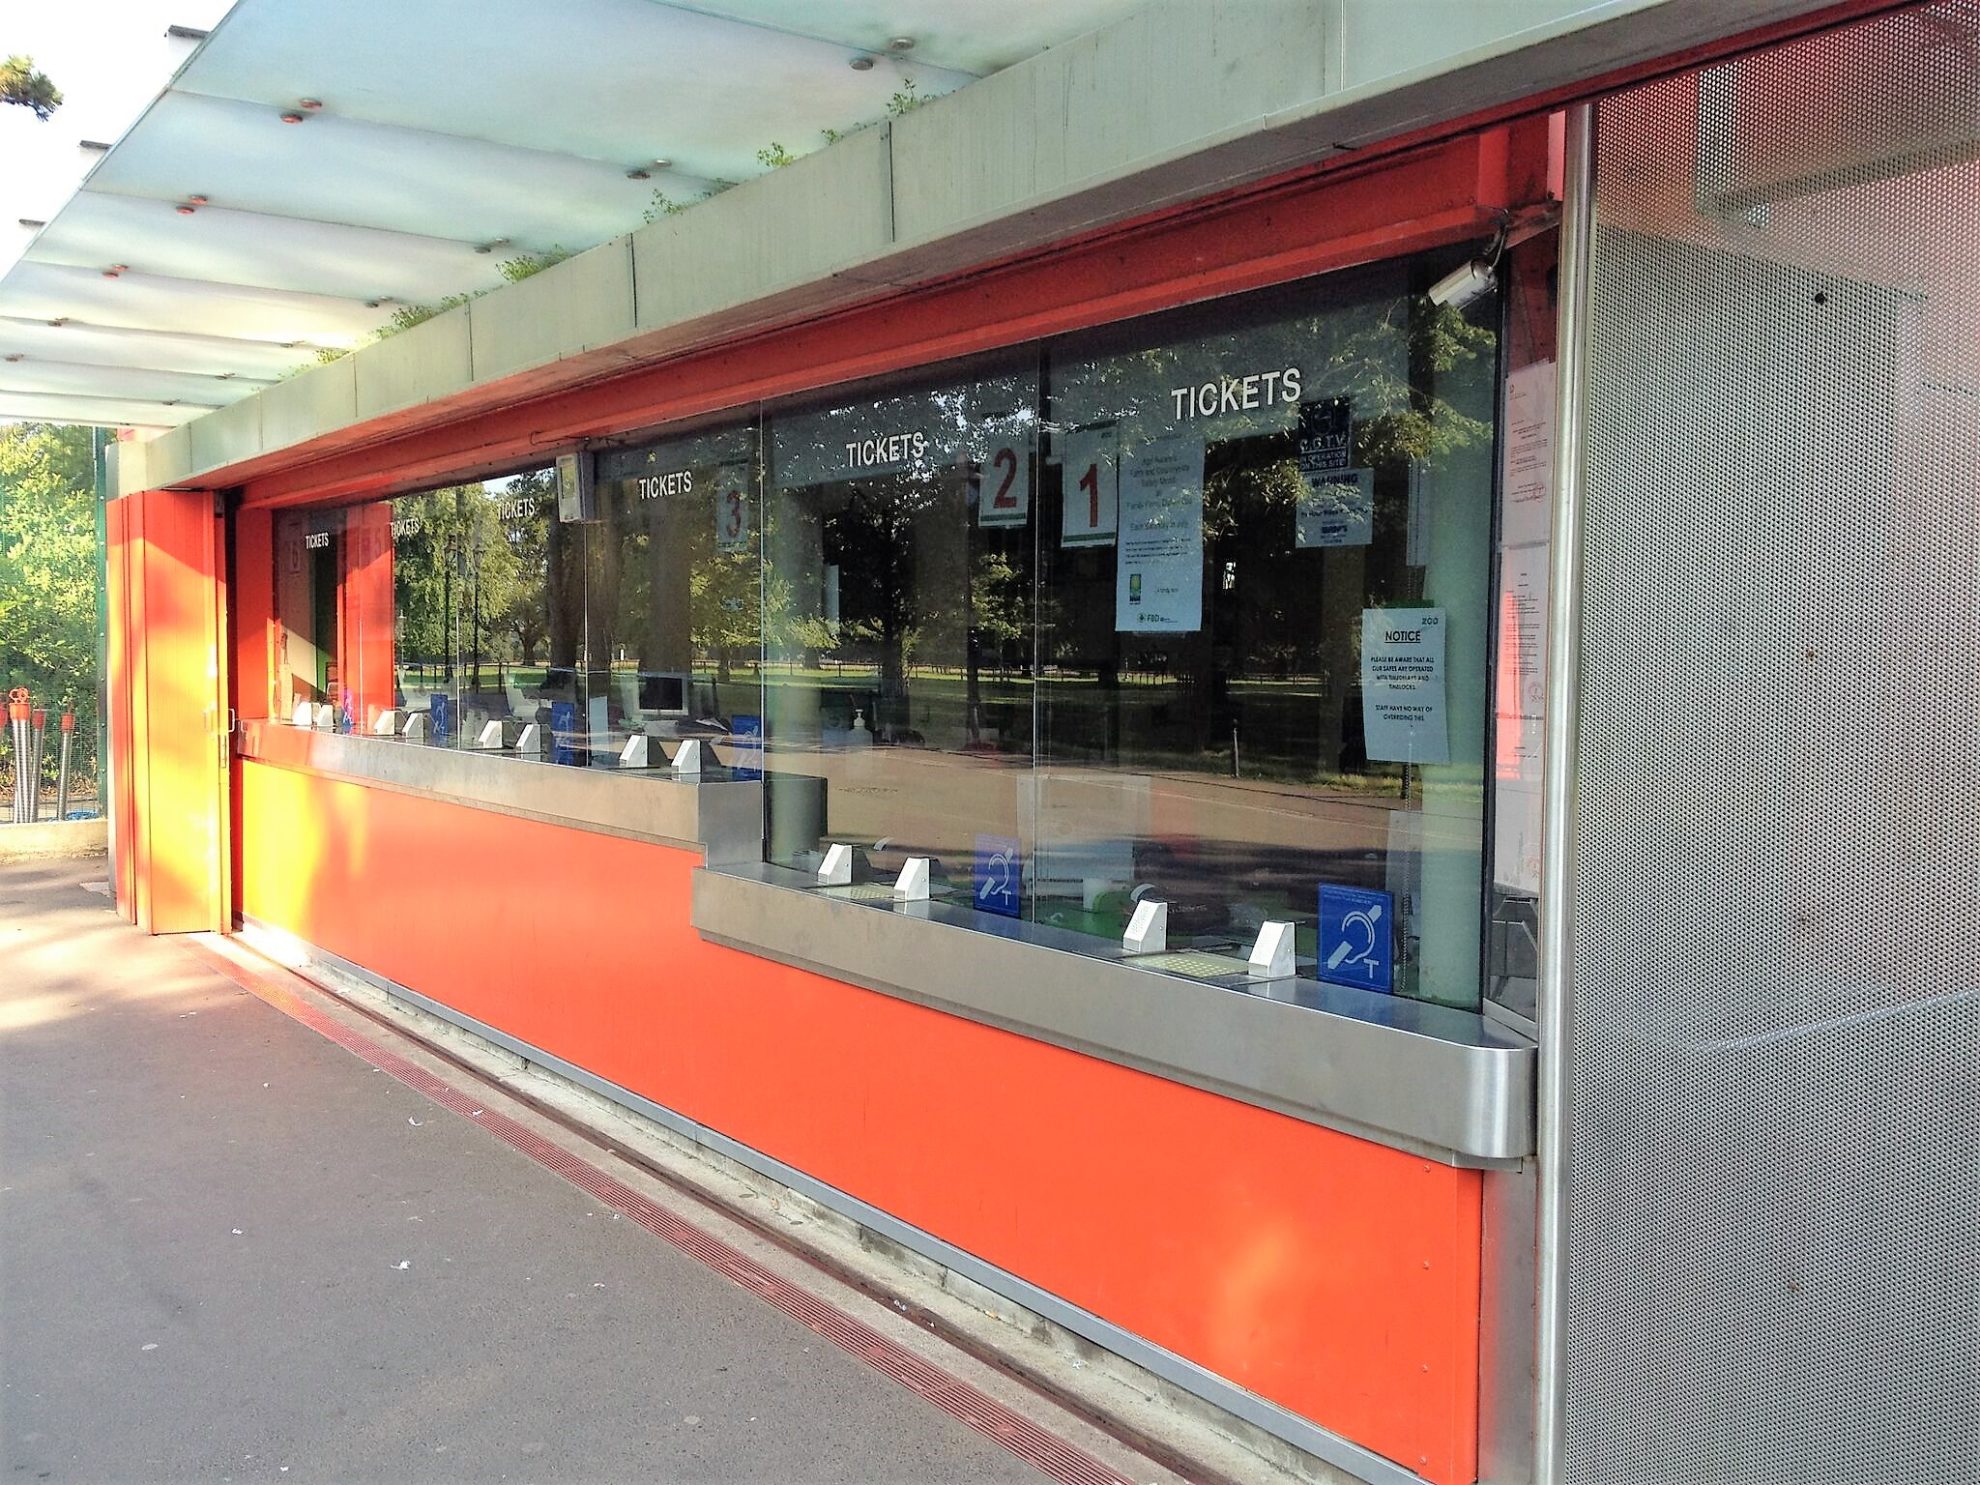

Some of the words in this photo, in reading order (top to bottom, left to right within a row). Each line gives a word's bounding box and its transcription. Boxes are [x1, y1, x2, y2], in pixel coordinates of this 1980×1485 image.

[1171, 368, 1301, 420] TICKETS
[845, 431, 926, 468] TICKETS
[639, 471, 692, 499] TICKETS
[993, 448, 1018, 509] 2
[1311, 472, 1358, 488] WARNING
[1079, 463, 1099, 528] 1
[498, 498, 536, 520] TICKETS
[727, 490, 741, 538] 3
[305, 532, 329, 549] TICKETS
[390, 517, 421, 540] TICKETS
[1385, 630, 1421, 642] NOTICE
[1408, 665, 1434, 673] OPERATED
